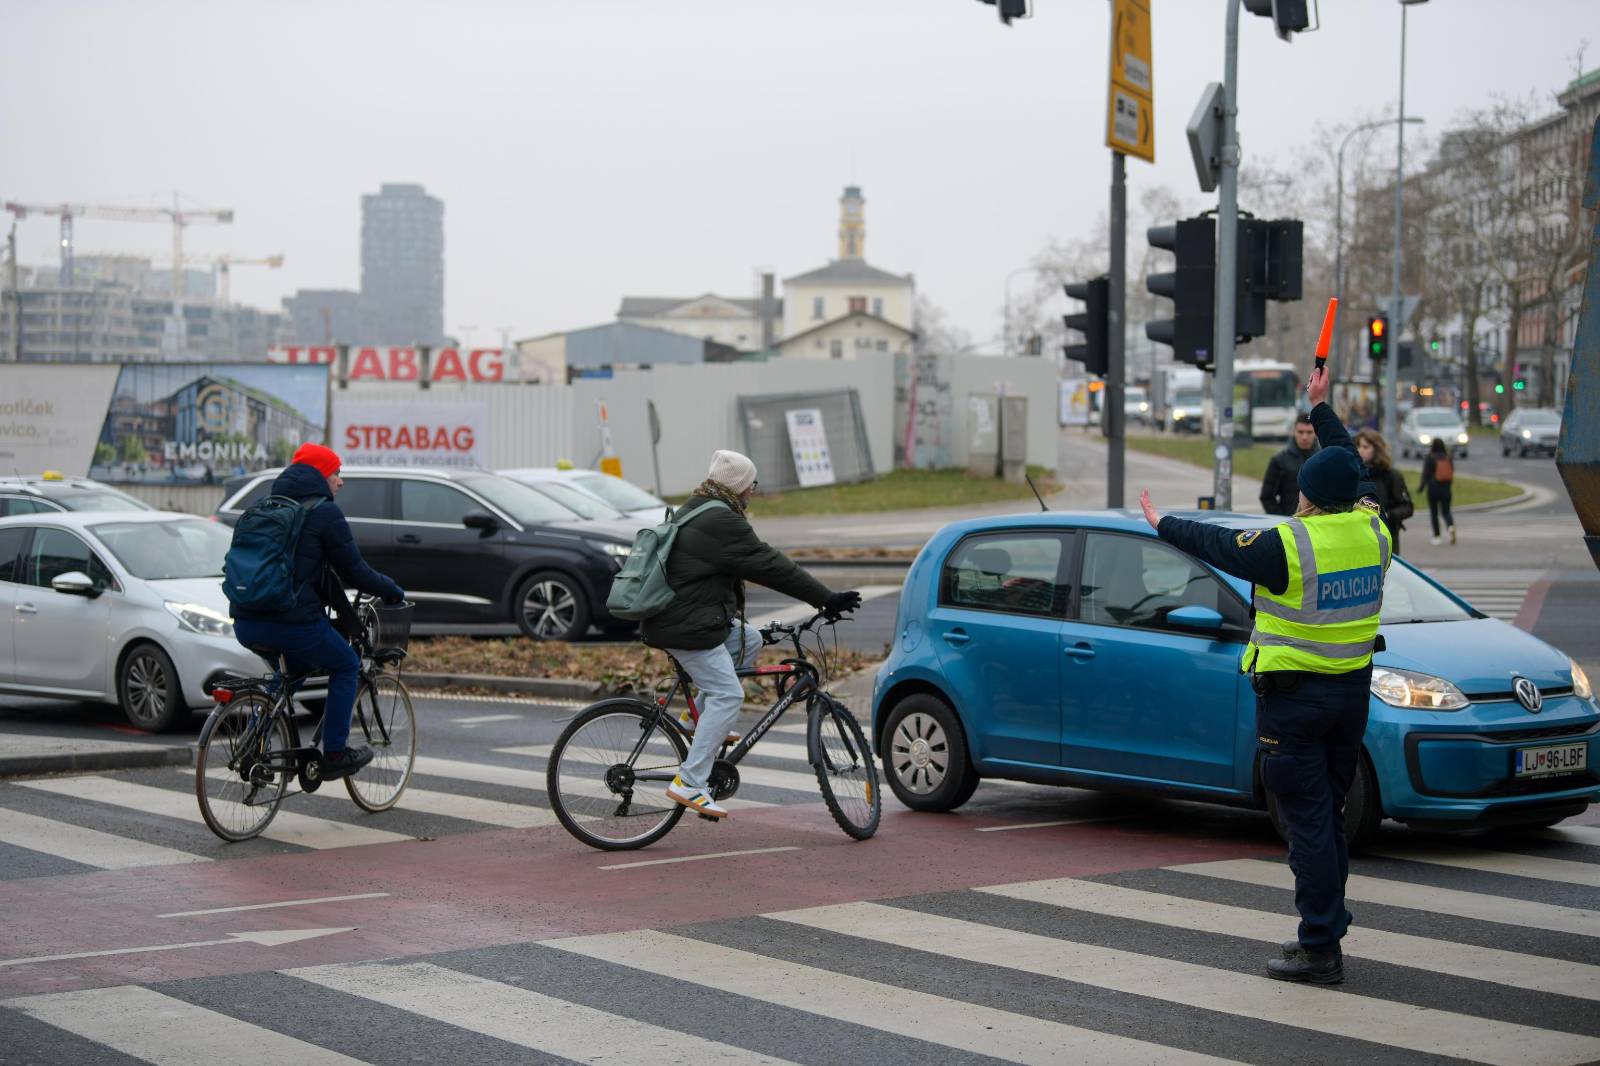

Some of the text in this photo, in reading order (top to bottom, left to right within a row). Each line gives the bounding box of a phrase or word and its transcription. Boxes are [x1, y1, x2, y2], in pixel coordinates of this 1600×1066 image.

[164, 441, 268, 460] EMONIKA
[345, 425, 475, 451] STRABAG
[1321, 574, 1379, 600] POLICIJA
[1525, 747, 1584, 771] LJ 96-LBF
